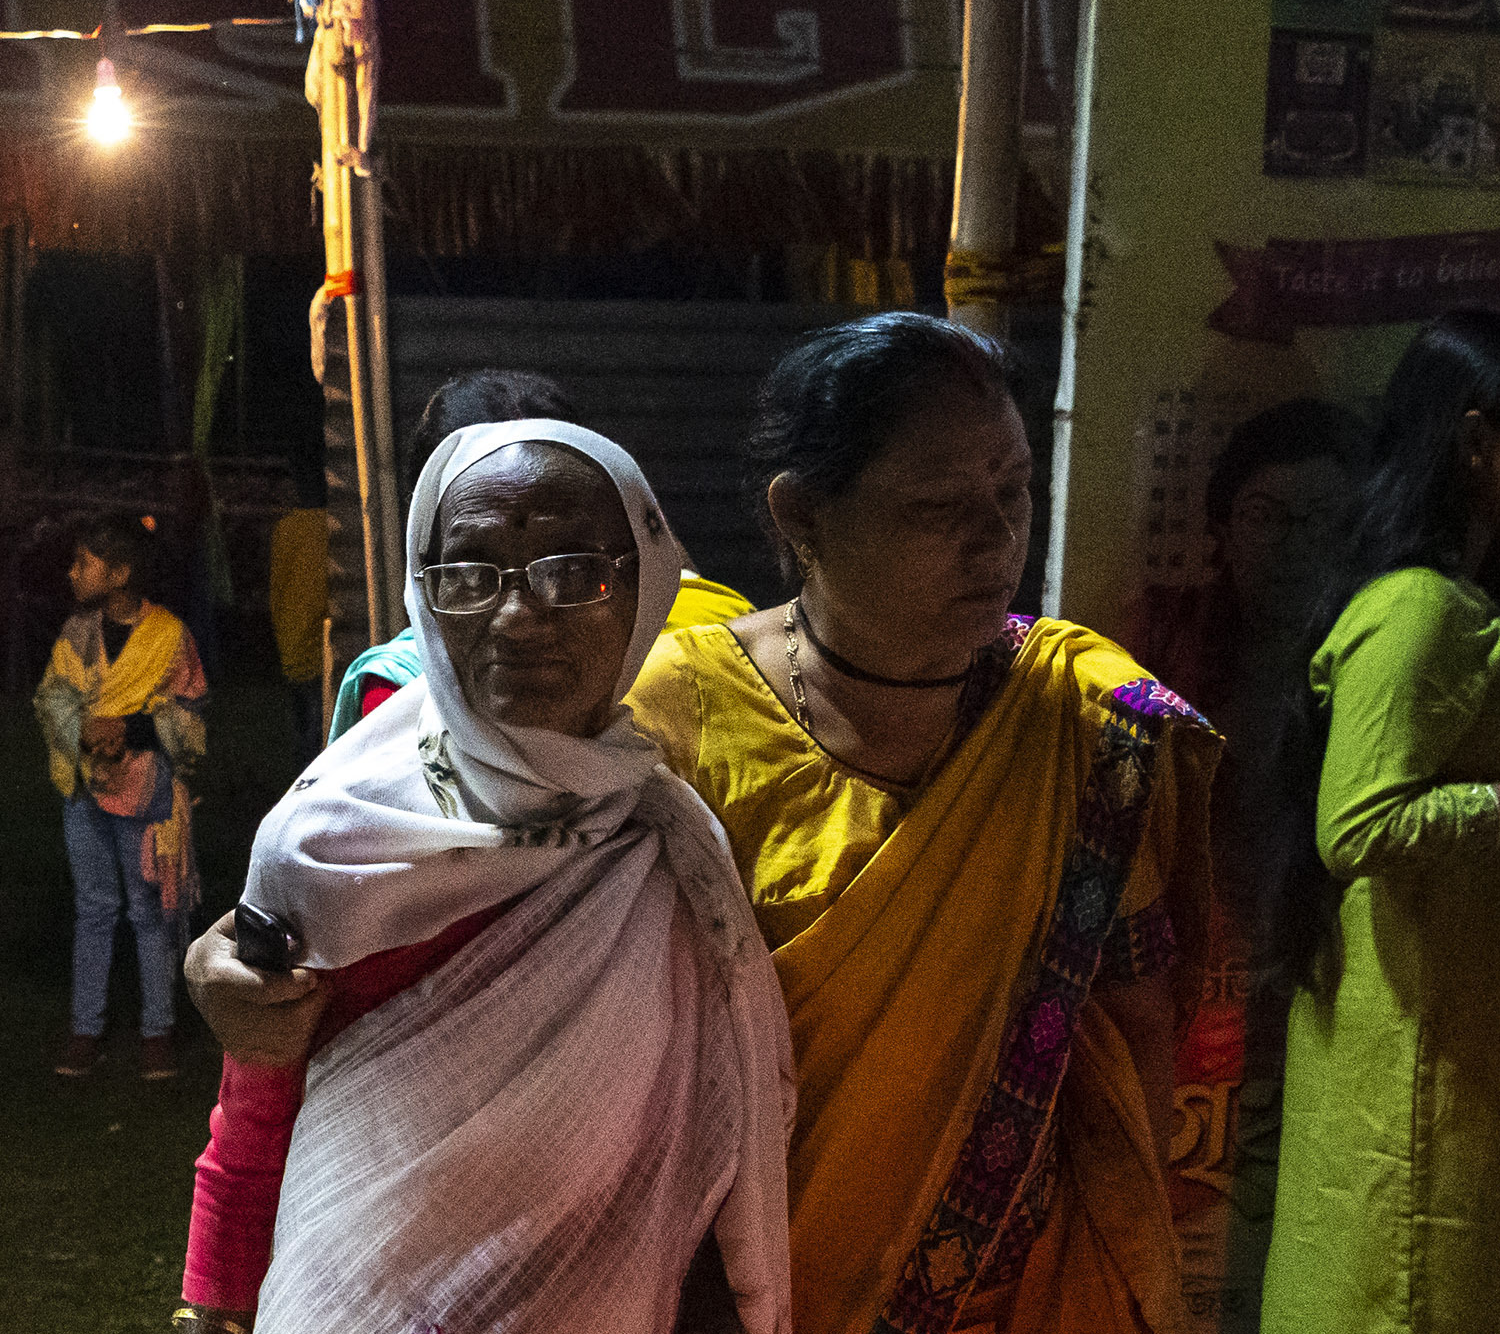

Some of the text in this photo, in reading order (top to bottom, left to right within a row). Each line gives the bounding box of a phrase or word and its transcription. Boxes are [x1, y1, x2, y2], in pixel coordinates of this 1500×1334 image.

[1272, 264, 1348, 295] Taste
[1360, 262, 1383, 292] it
[1394, 259, 1425, 287] to
